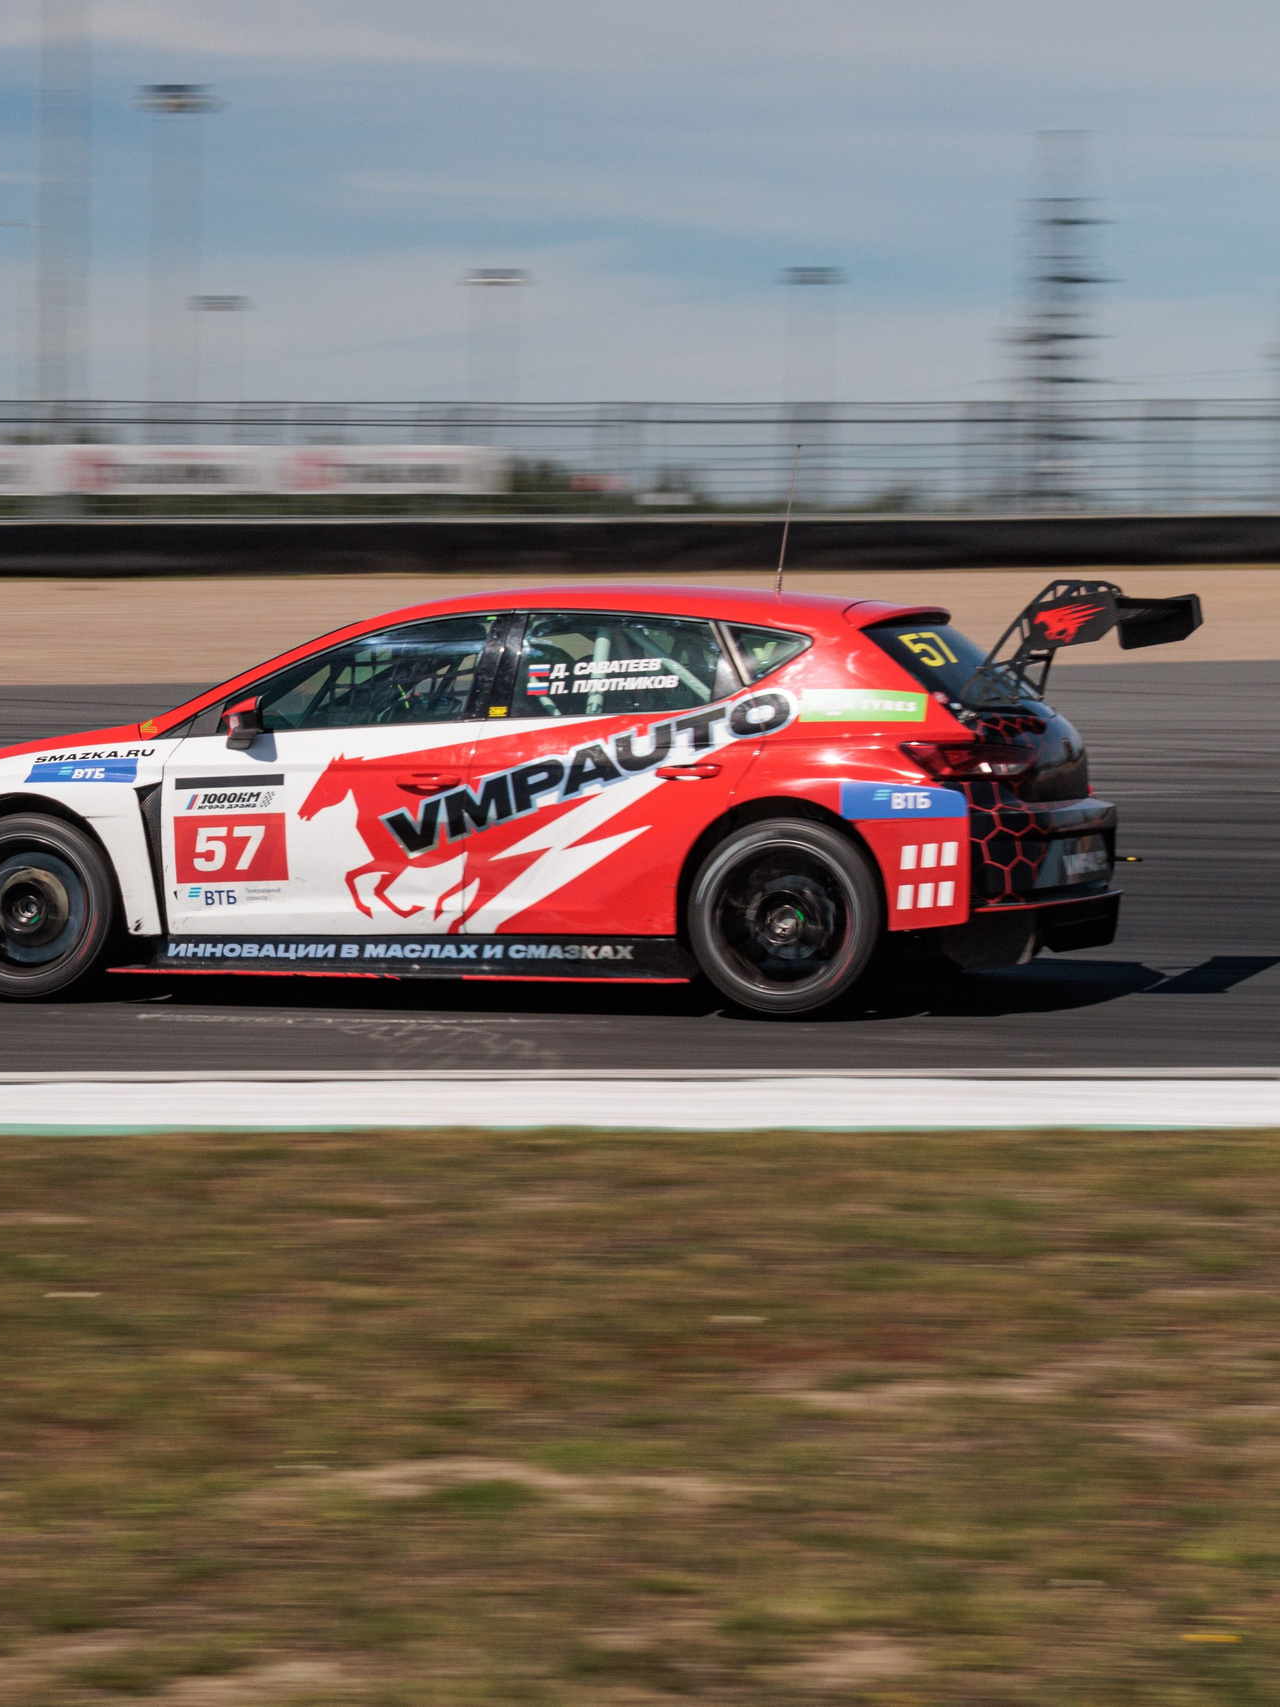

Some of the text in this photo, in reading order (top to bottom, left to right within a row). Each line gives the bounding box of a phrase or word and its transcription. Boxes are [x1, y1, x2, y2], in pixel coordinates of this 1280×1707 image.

[897, 631, 959, 667] 57
[549, 658, 663, 679] Д. САВАТЕЕВ
[549, 675, 680, 695] П. ПЛОТНИКОВ
[34, 748, 156, 764] SMAZKA.RU
[71, 767, 106, 779] ВТБ
[380, 688, 797, 857] VMPAUTO
[890, 791, 932, 810] ВТБ
[193, 825, 266, 872] 57
[204, 890, 237, 906] ВТБ
[167, 943, 635, 960] ИННОВАЦИИ В МАСЛАХ И СМАЗКАХ
